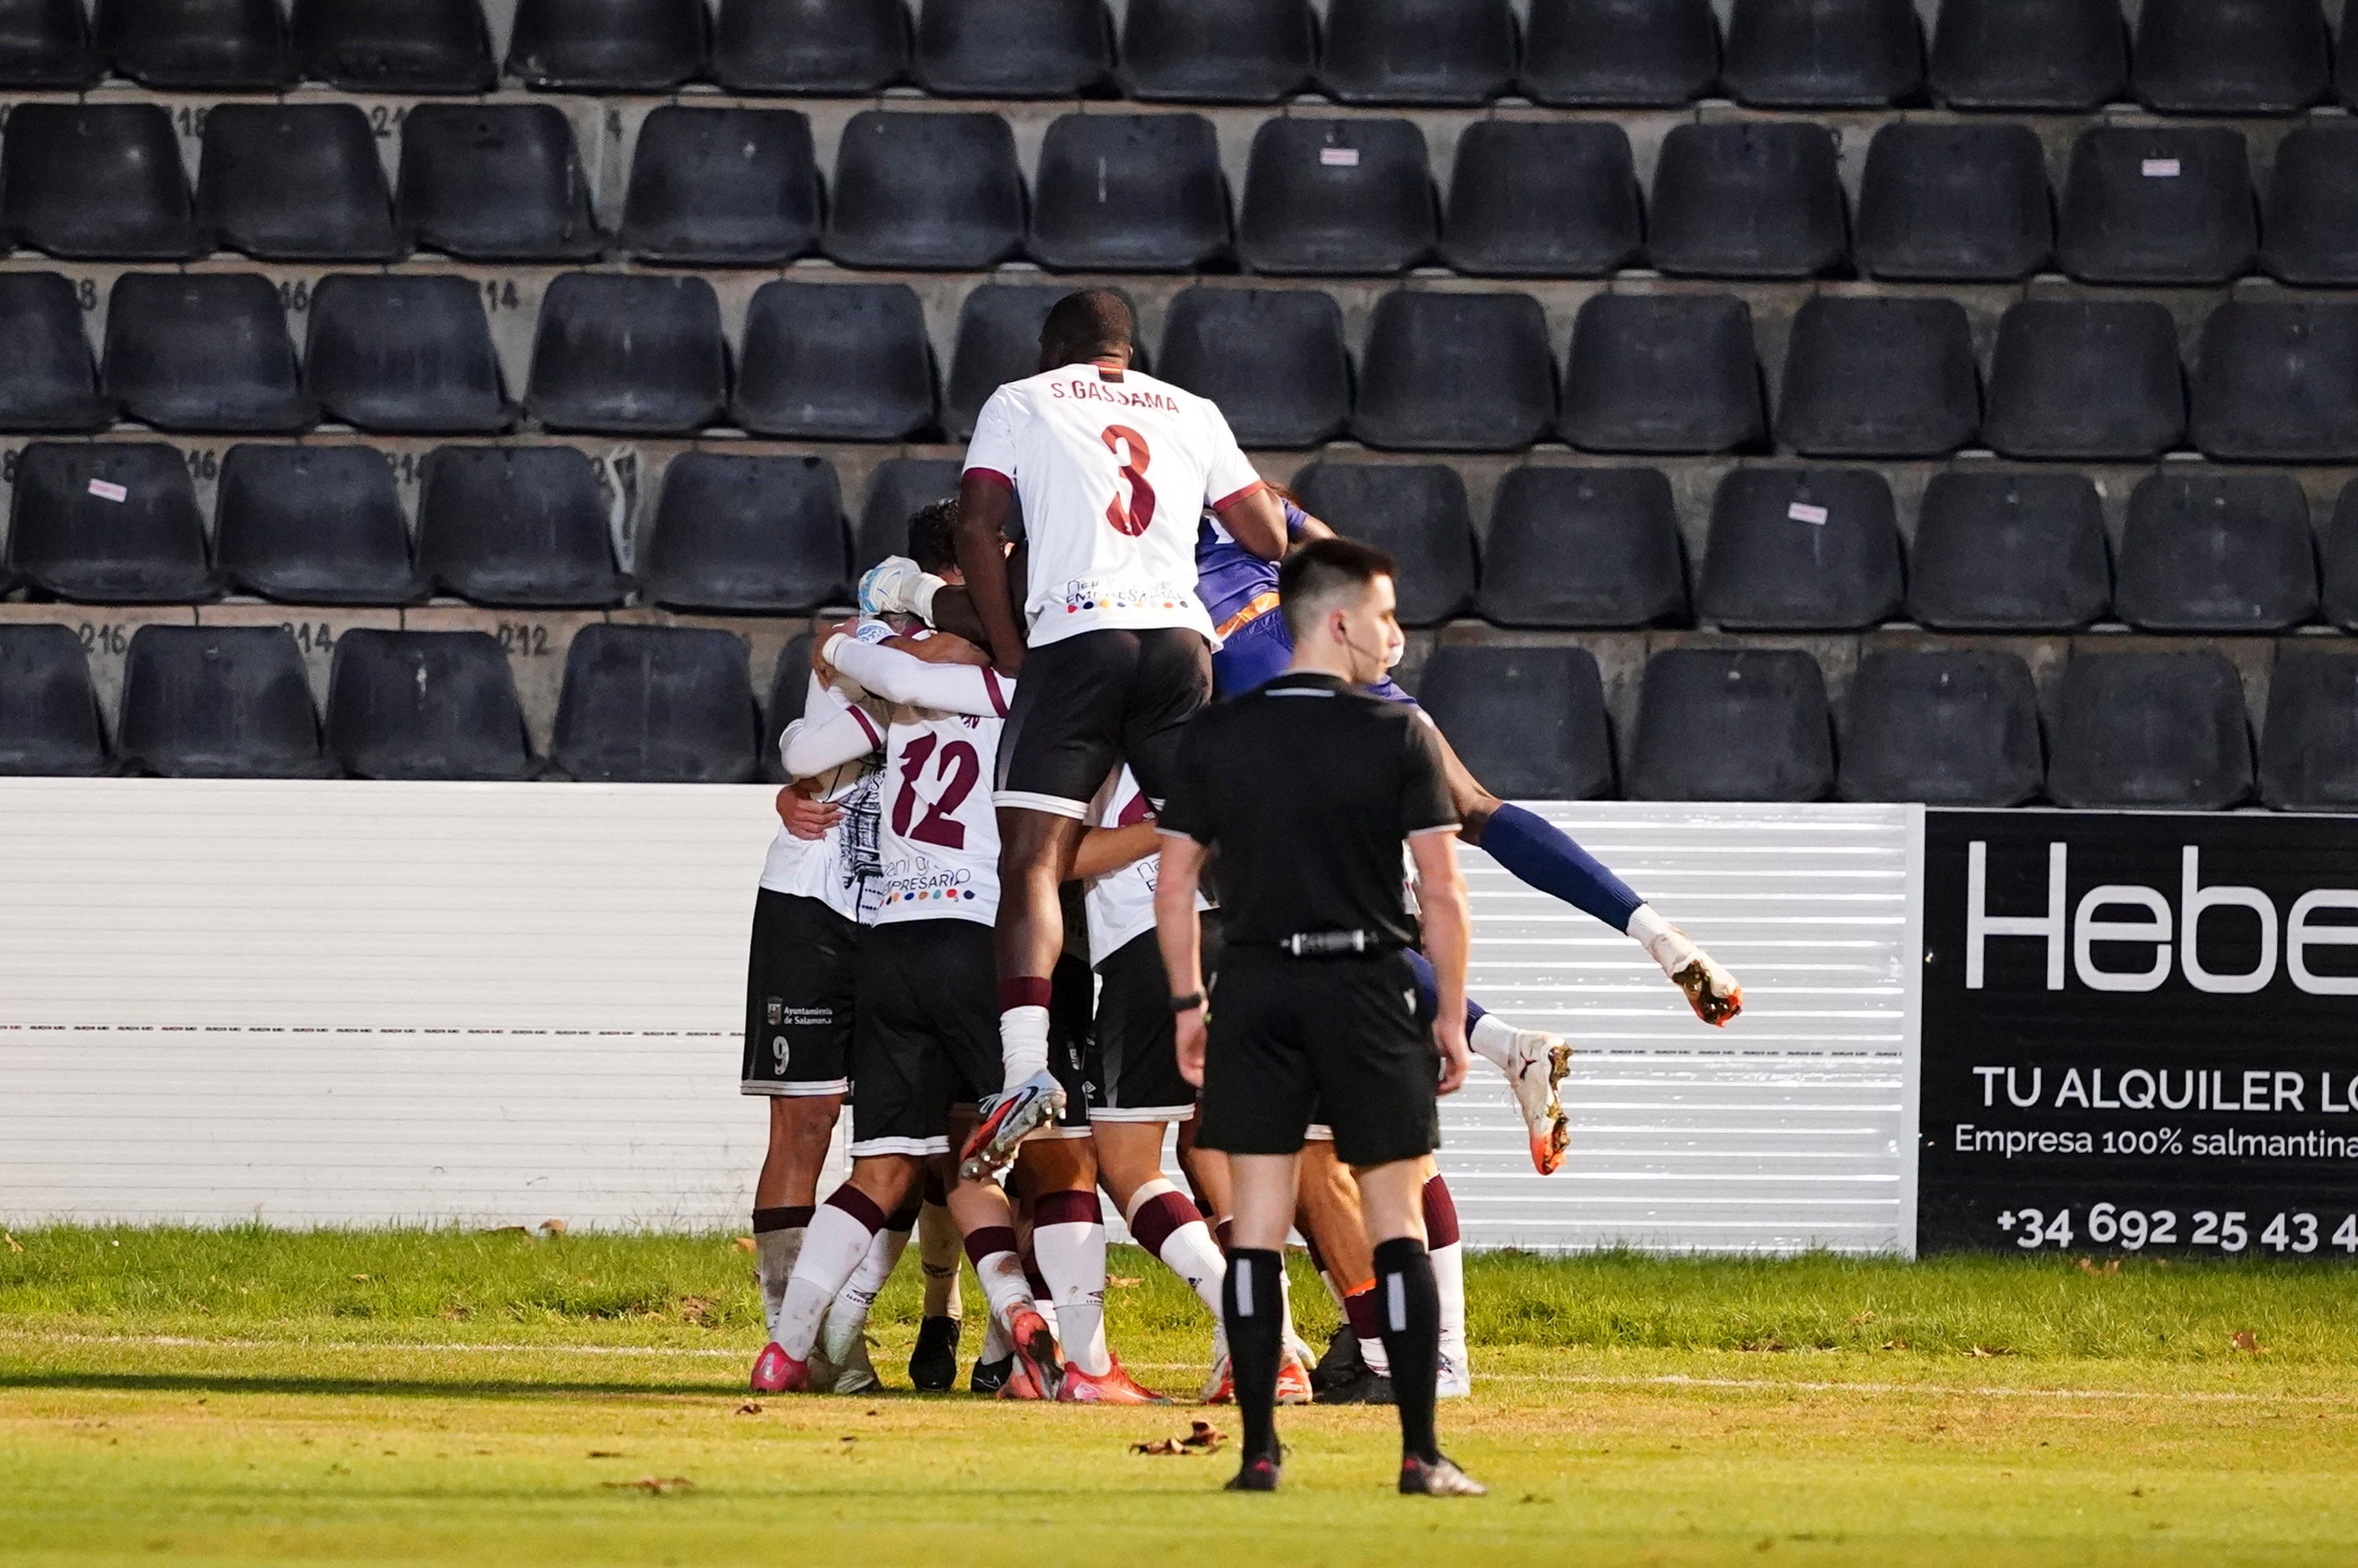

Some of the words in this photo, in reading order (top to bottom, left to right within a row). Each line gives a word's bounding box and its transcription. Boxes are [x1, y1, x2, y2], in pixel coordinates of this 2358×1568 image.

[1050, 380, 1180, 413] S.GASSAMA
[1101, 424, 1155, 536] 3
[79, 622, 127, 655] 216
[498, 622, 551, 657] 212
[892, 730, 980, 850] 12
[1966, 840, 2358, 995] Hebe
[784, 1016, 793, 1025] de
[773, 1035, 789, 1076] 9
[1973, 1066, 2042, 1107] TU
[2054, 1068, 2305, 1112] ALQUILER
[2321, 1071, 2358, 1113] L
[1956, 1124, 2093, 1159] Empresa
[2102, 1127, 2184, 1155] 100%
[2191, 1127, 2358, 1159] salmantina
[1997, 1208, 2074, 1248] +34
[2088, 1202, 2177, 1250] 692
[2191, 1210, 2248, 1252] 25
[2261, 1212, 2319, 1253] 43
[2331, 1213, 2358, 1253] 4
